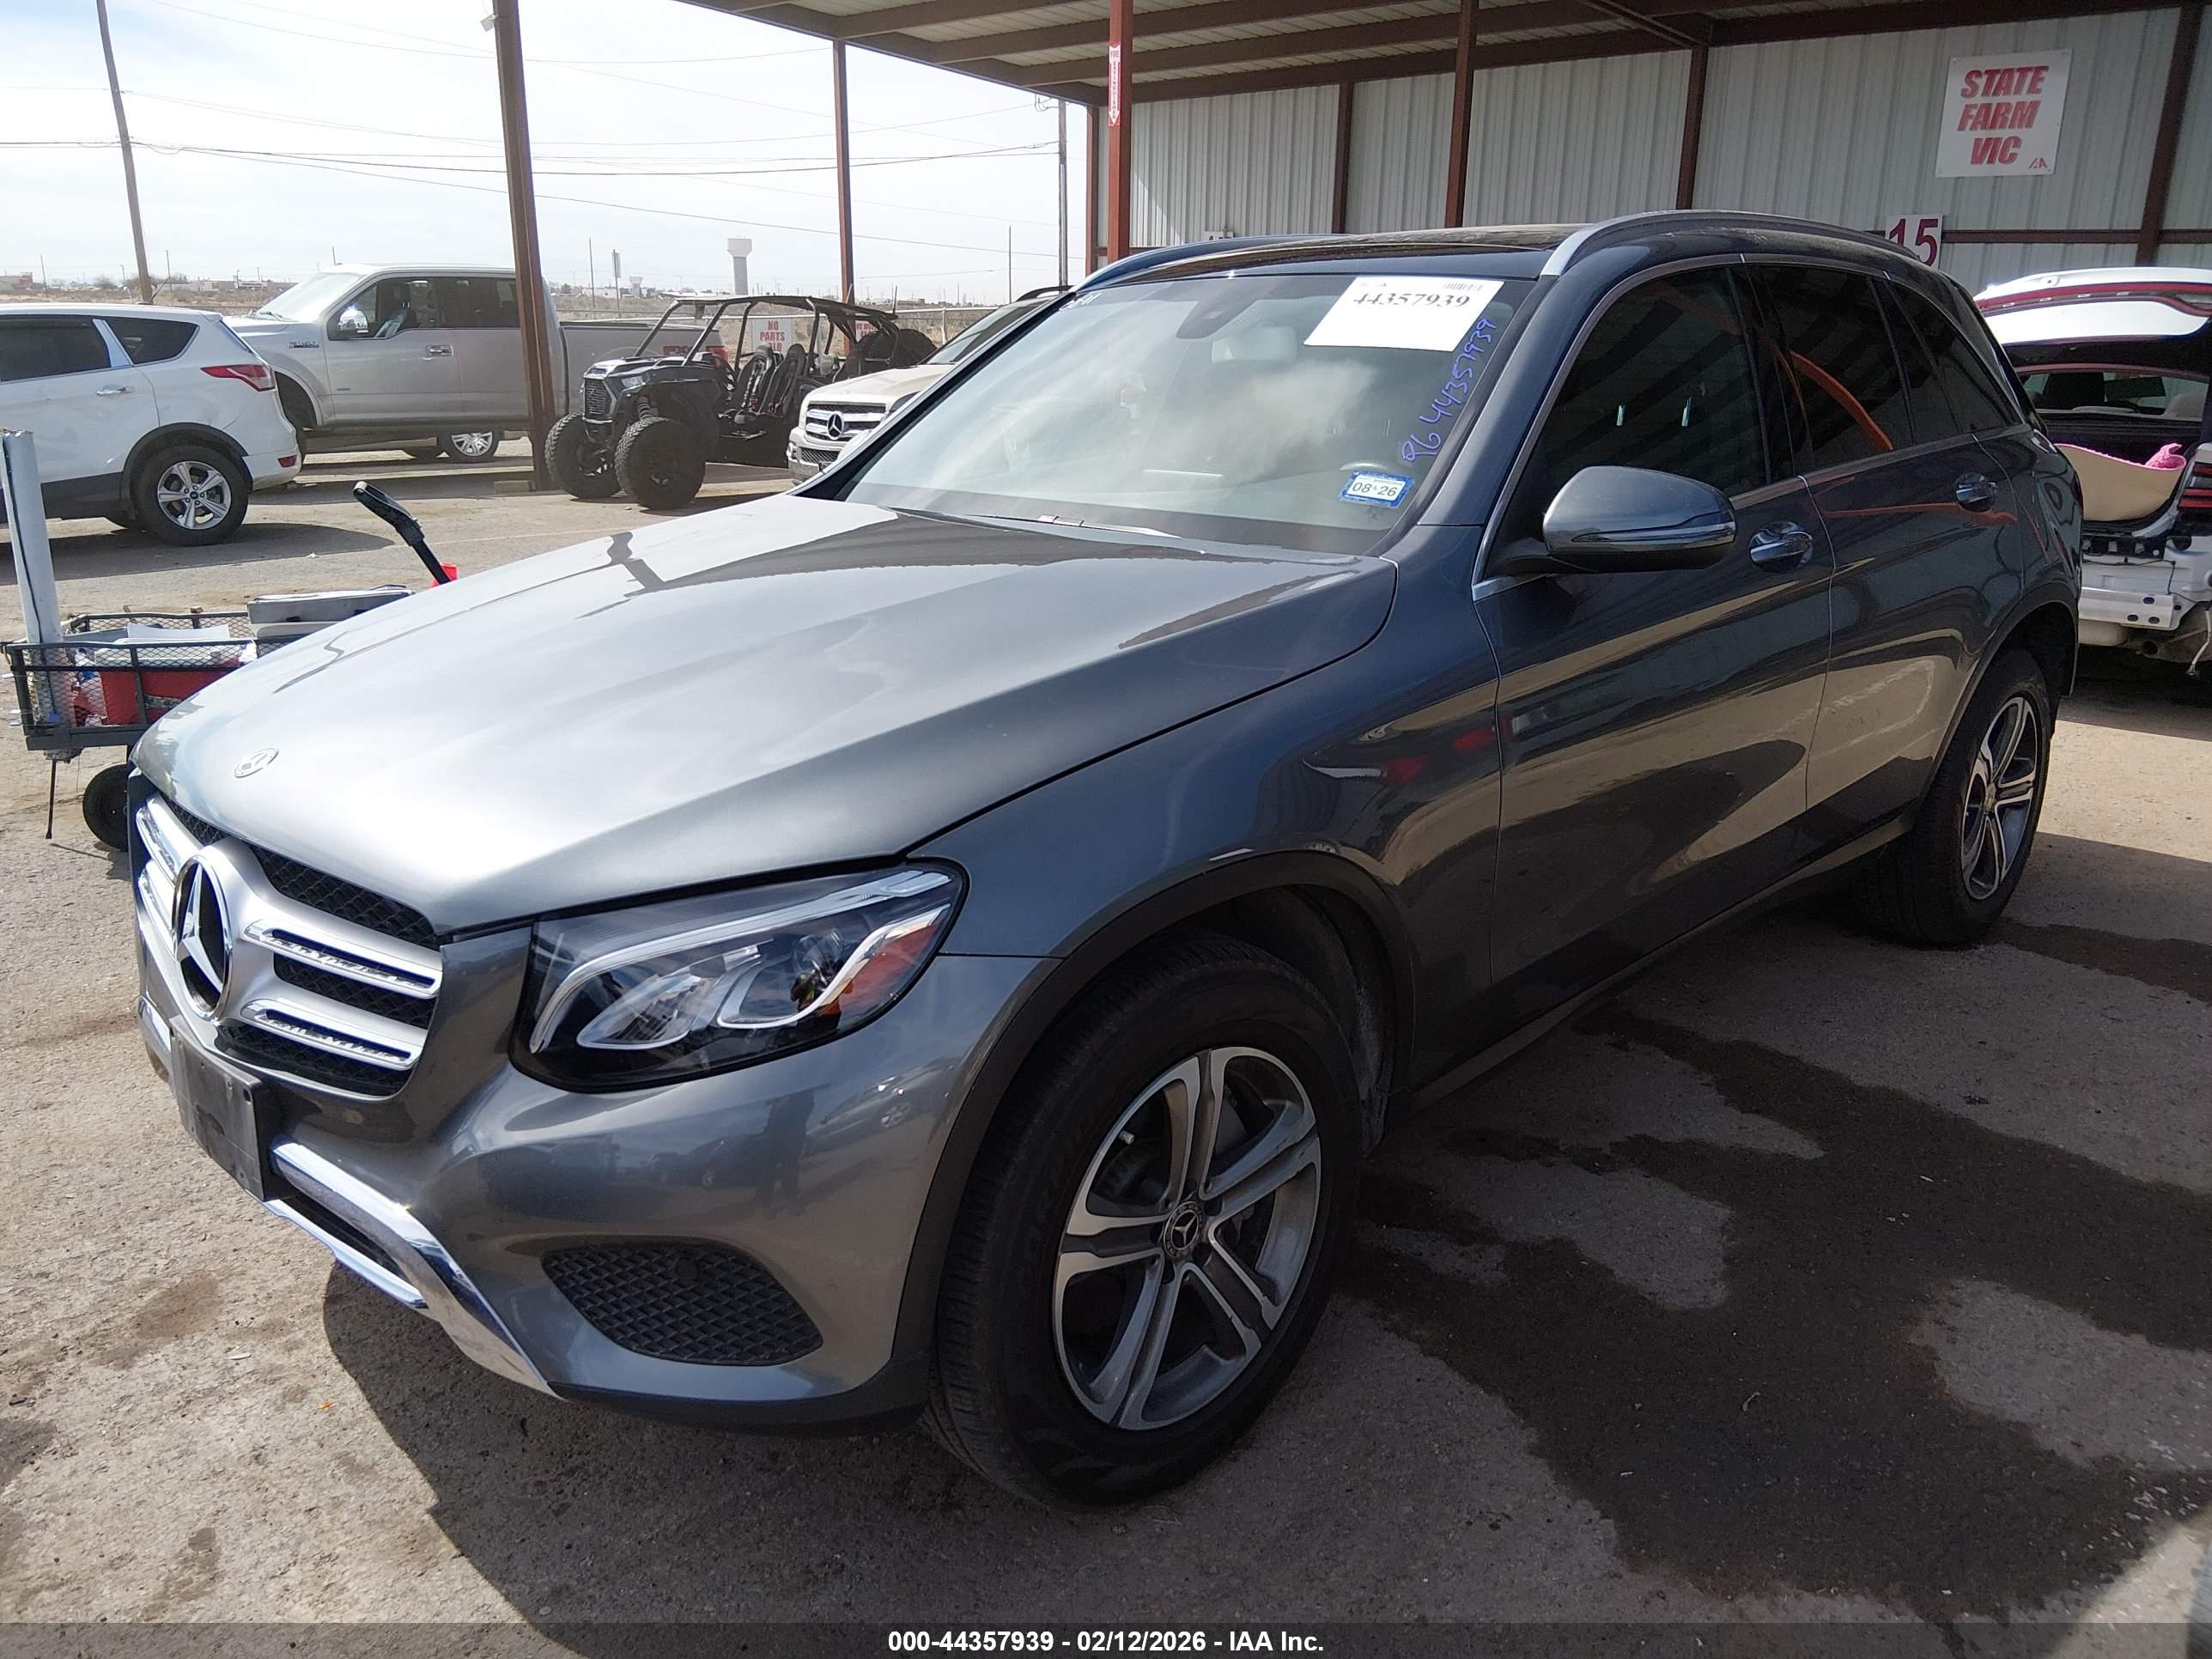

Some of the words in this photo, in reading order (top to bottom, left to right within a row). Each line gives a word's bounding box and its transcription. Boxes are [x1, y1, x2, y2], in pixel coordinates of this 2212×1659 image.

[1960, 65, 2050, 99] STATE
[1957, 100, 2041, 131] FARM
[1970, 136, 2022, 166] VIC
[1888, 218, 1939, 267] 15
[1353, 293, 1471, 308] 44357939
[760, 331, 785, 342] PARTS
[768, 320, 779, 331] NO
[1419, 318, 1498, 423] 44357939
